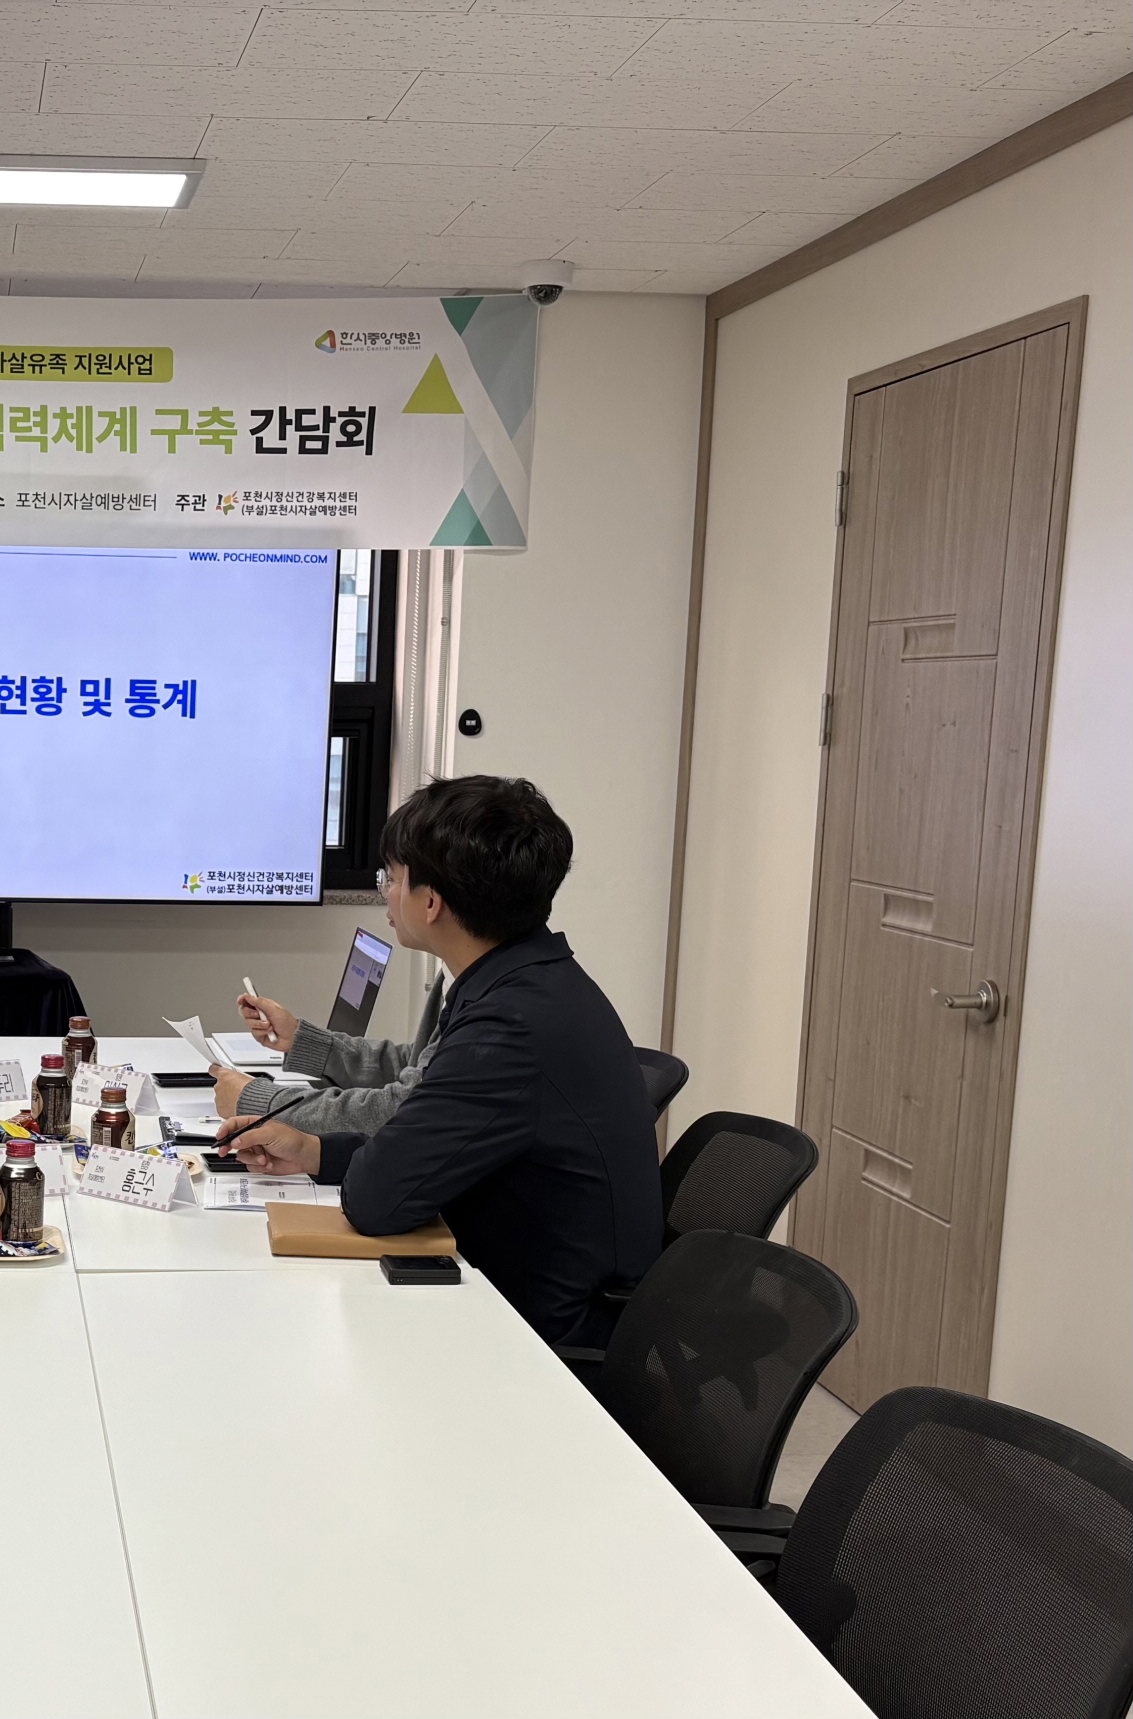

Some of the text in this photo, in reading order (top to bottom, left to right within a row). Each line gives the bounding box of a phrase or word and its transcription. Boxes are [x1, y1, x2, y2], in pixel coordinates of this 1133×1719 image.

[73, 352, 154, 376] 지원사업
[150, 406, 238, 455] 구축
[248, 405, 377, 456] 간담회
[15, 491, 157, 512] 포천시자살예방센터
[174, 493, 208, 512] 주관
[242, 490, 358, 503] 포천시정신건강복지센터
[241, 504, 357, 516] (부설)포천시자살예방센터
[189, 551, 328, 565] WWW. POCHEONMIND.COM
[79, 677, 113, 718] 및
[124, 678, 197, 720] 통계
[207, 870, 314, 883] 포천시정신건강복지센터
[206, 884, 313, 895] (부설)포천시자살예방센터
